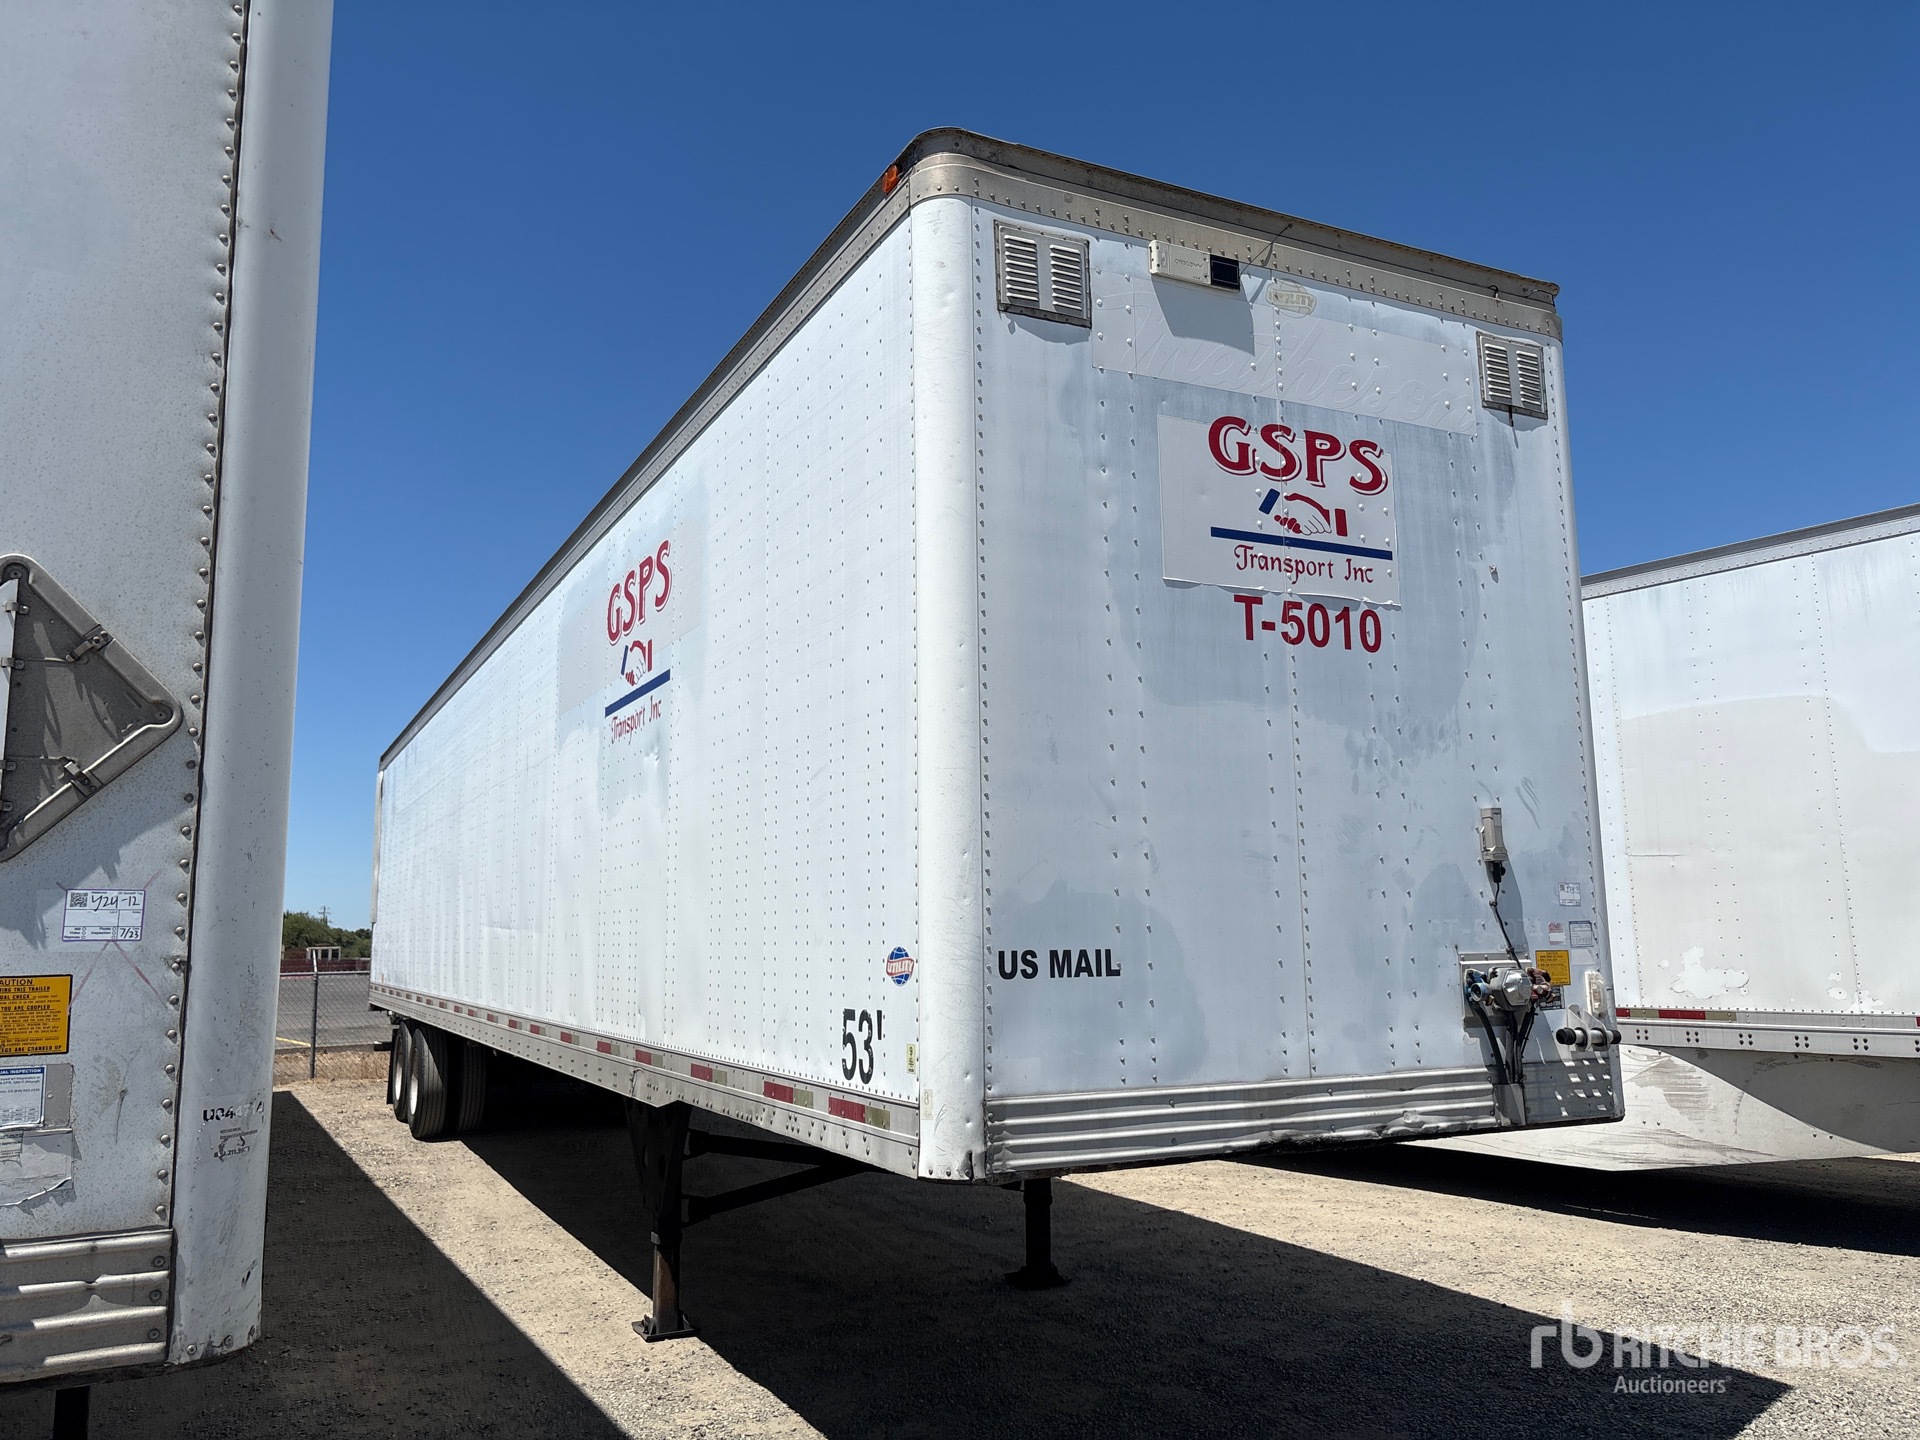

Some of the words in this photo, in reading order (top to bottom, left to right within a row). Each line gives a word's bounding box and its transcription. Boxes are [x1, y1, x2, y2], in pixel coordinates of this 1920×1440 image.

[1208, 416, 1388, 496] GSPS
[1233, 545, 1334, 584] Transport
[1346, 559, 1374, 583] Inc
[606, 539, 673, 646] GSPS
[1234, 594, 1382, 653] T-5010
[611, 704, 646, 744] Transport
[649, 695, 662, 722] Inc
[888, 959, 913, 974] UTILITY
[997, 949, 1039, 980] US
[1049, 948, 1121, 978] MAIL
